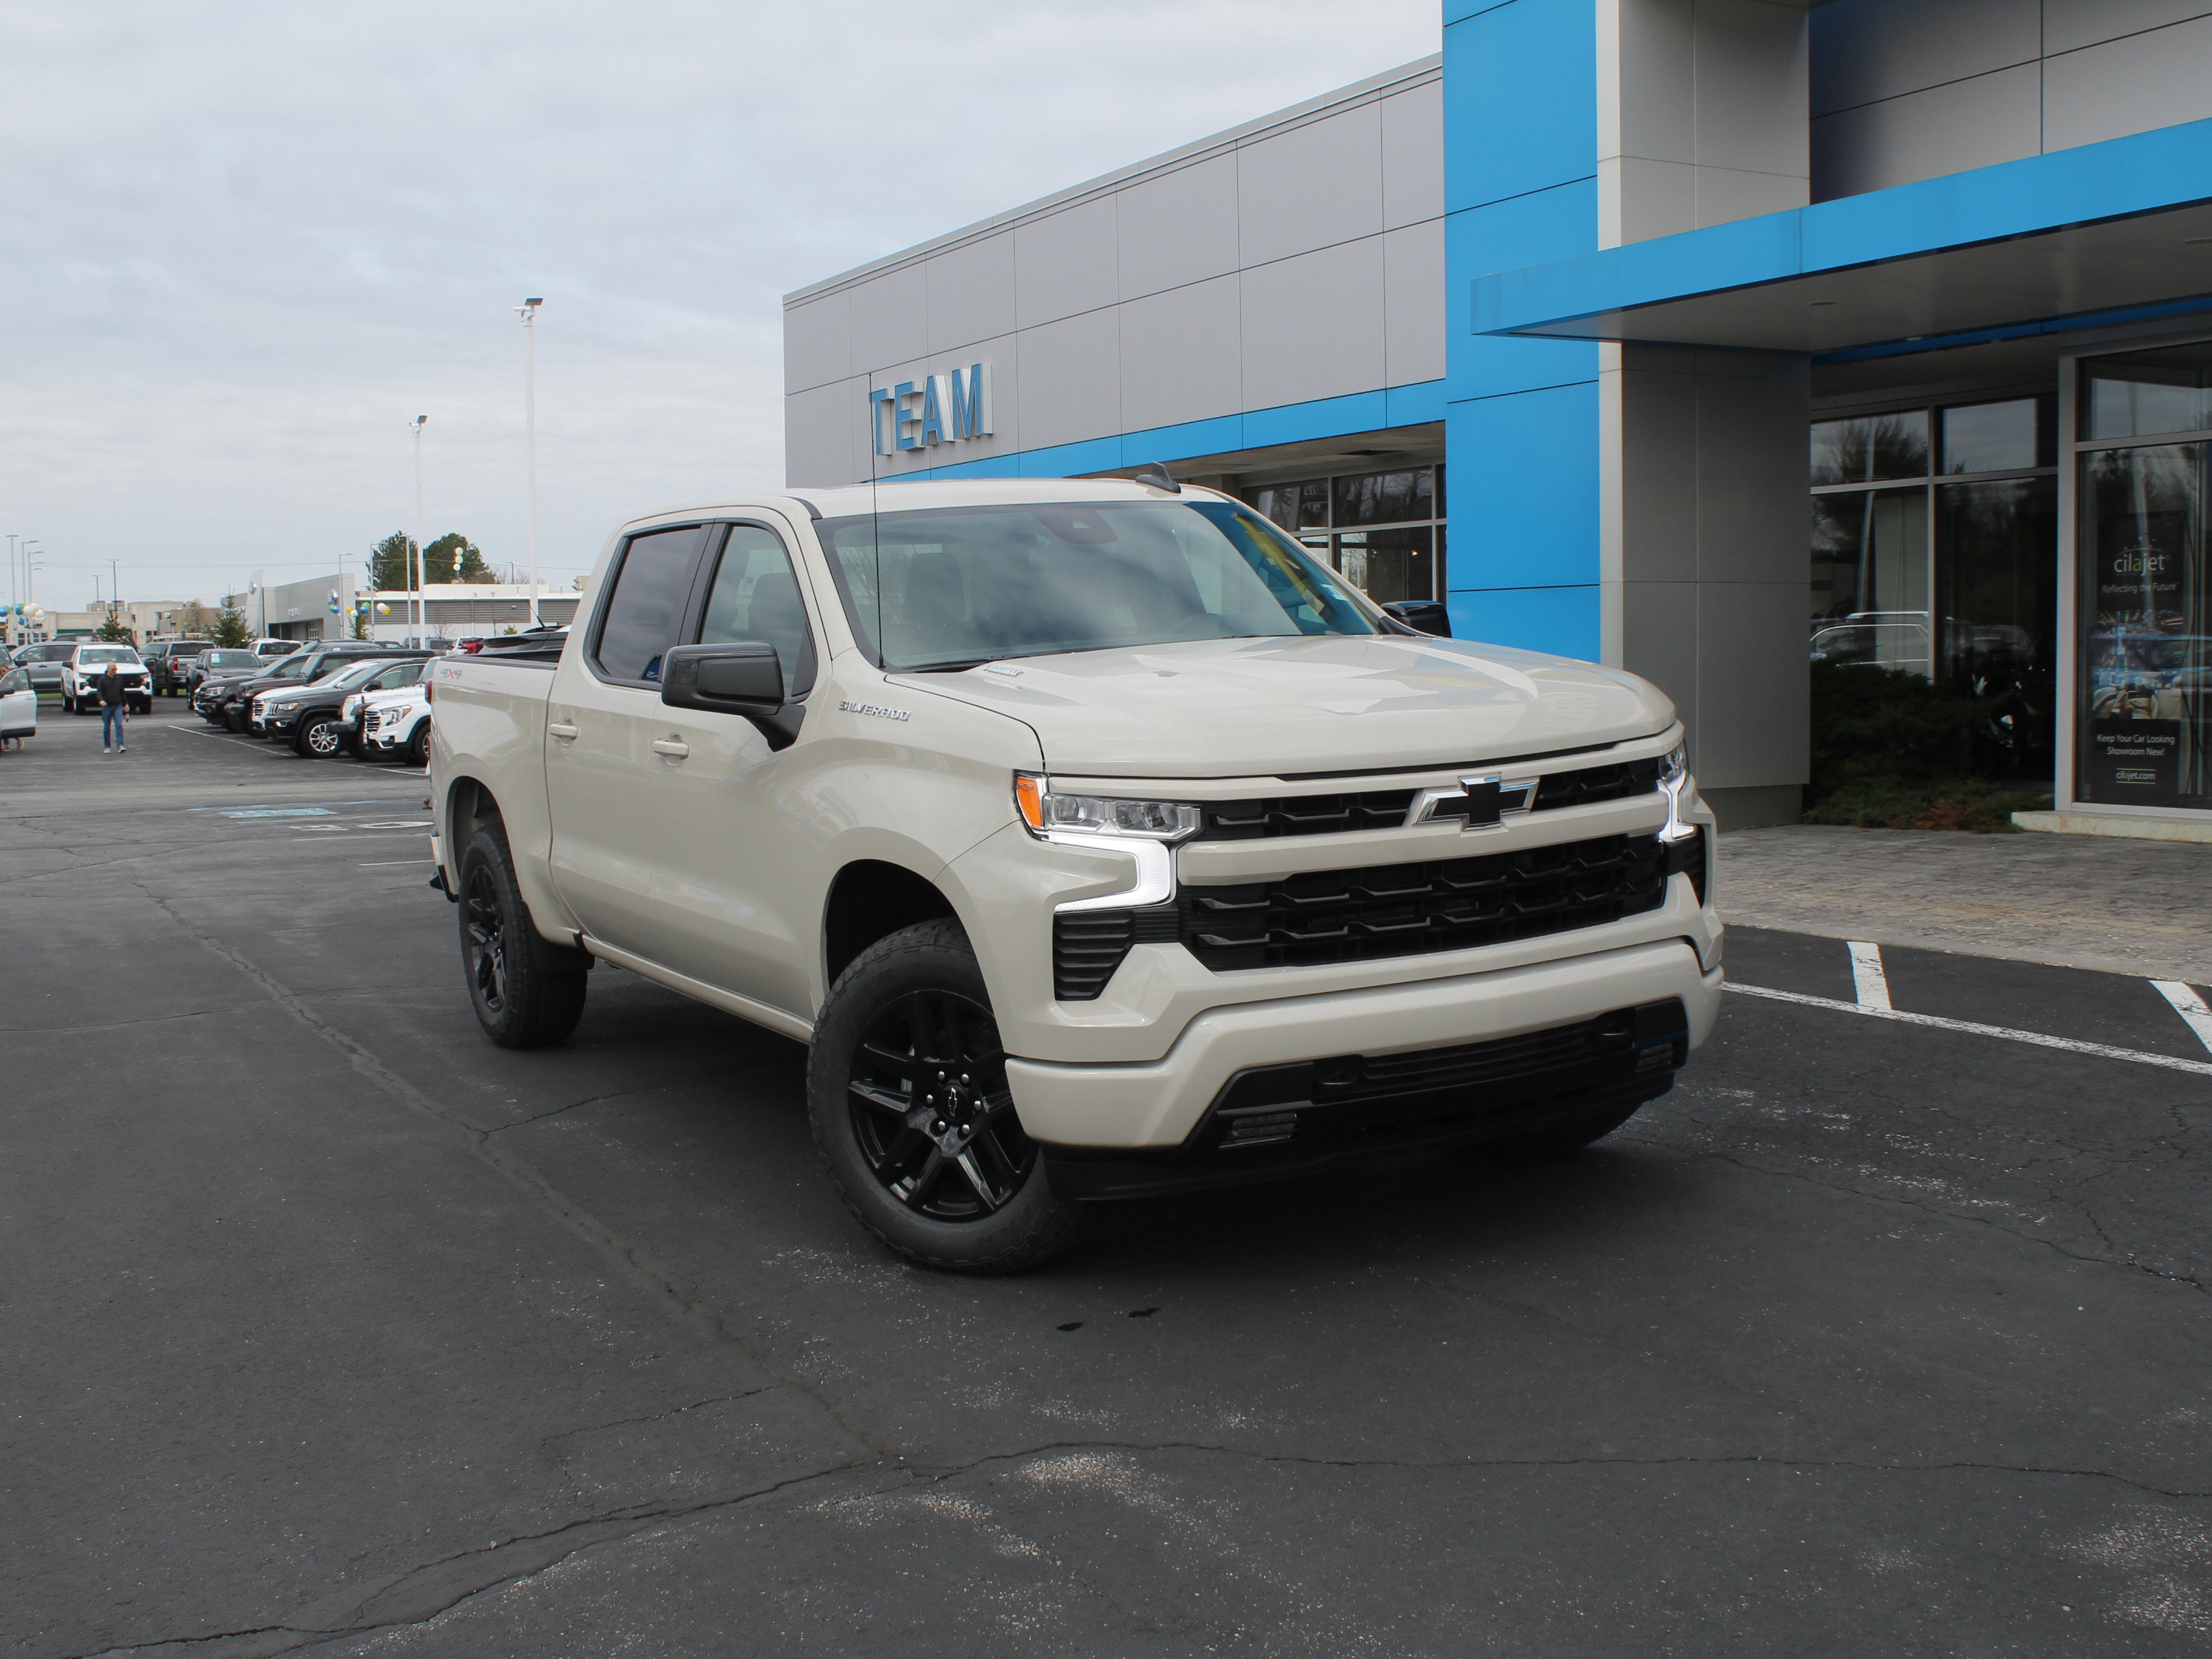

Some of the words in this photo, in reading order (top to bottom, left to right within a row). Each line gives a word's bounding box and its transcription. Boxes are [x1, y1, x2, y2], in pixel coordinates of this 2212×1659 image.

[868, 363, 994, 456] TEAM
[2113, 553, 2166, 576] cilajet
[2102, 584, 2138, 594] Reflecting
[2139, 583, 2152, 592] the
[838, 700, 912, 721] SILVERADO
[2096, 734, 2116, 743] Keep
[2146, 735, 2175, 745] Looking
[2106, 747, 2146, 755] Showroom
[2116, 771, 2155, 781] cilajet.com
